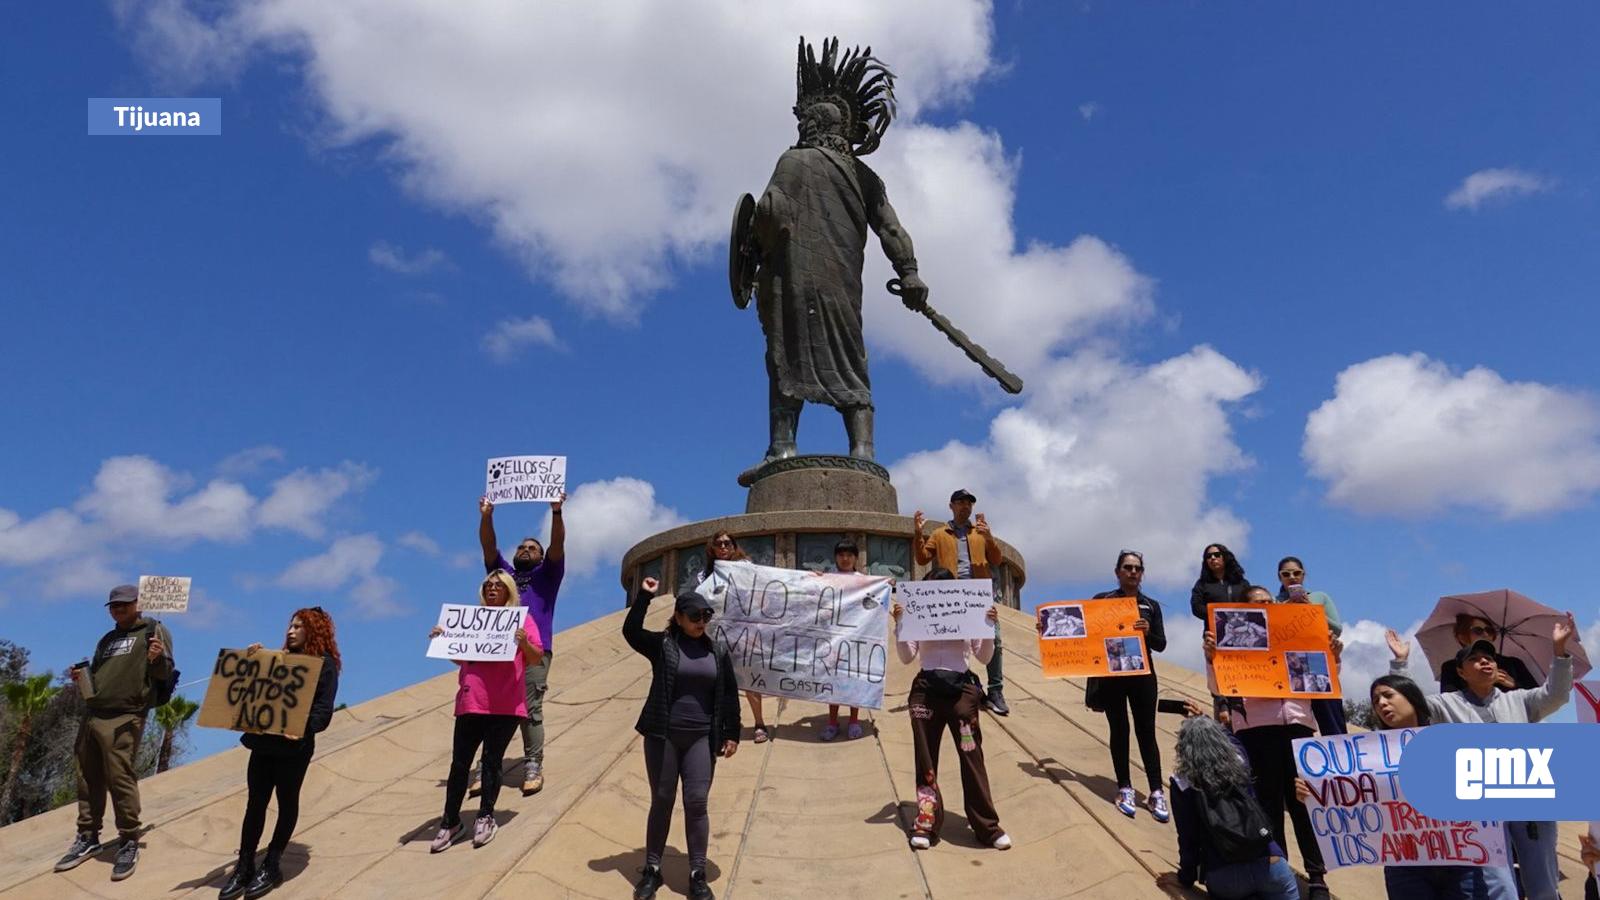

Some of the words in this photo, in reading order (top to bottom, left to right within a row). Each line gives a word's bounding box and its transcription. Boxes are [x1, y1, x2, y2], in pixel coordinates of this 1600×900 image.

[488, 475, 537, 489] TIENEN
[504, 459, 538, 475] ELLOS
[723, 572, 789, 620] NO
[814, 585, 857, 628] AL
[446, 607, 520, 632] JUSTICIA
[1272, 607, 1321, 645] JUSTICIA
[448, 642, 469, 655] SU
[475, 642, 508, 655] VOZ!
[715, 624, 887, 684] MALTRATO
[227, 678, 298, 708] GATOS
[749, 672, 767, 688] YA
[779, 677, 834, 695] BASTA
[1298, 734, 1374, 778] QUE
[1304, 773, 1379, 807] VIDA
[1311, 803, 1384, 837] COMO
[1330, 833, 1379, 867] LOS
[1380, 827, 1489, 866] ANIMALES
